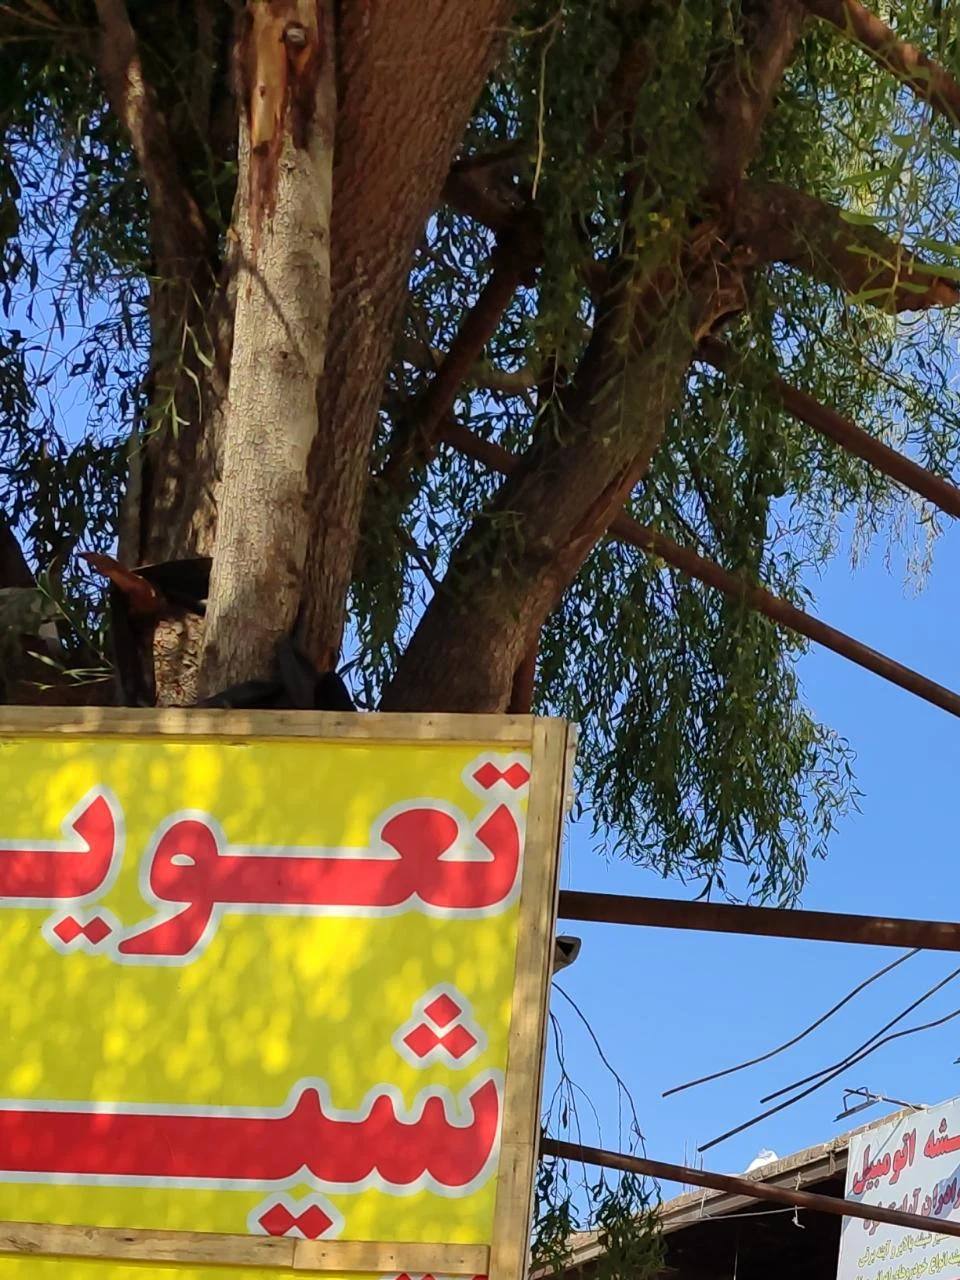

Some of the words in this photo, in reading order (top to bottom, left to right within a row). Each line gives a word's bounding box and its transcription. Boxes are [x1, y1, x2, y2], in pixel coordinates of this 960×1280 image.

[0, 761, 531, 957] تعوی
[0, 992, 500, 1240] شی
[852, 1127, 917, 1196] اتومبیل
